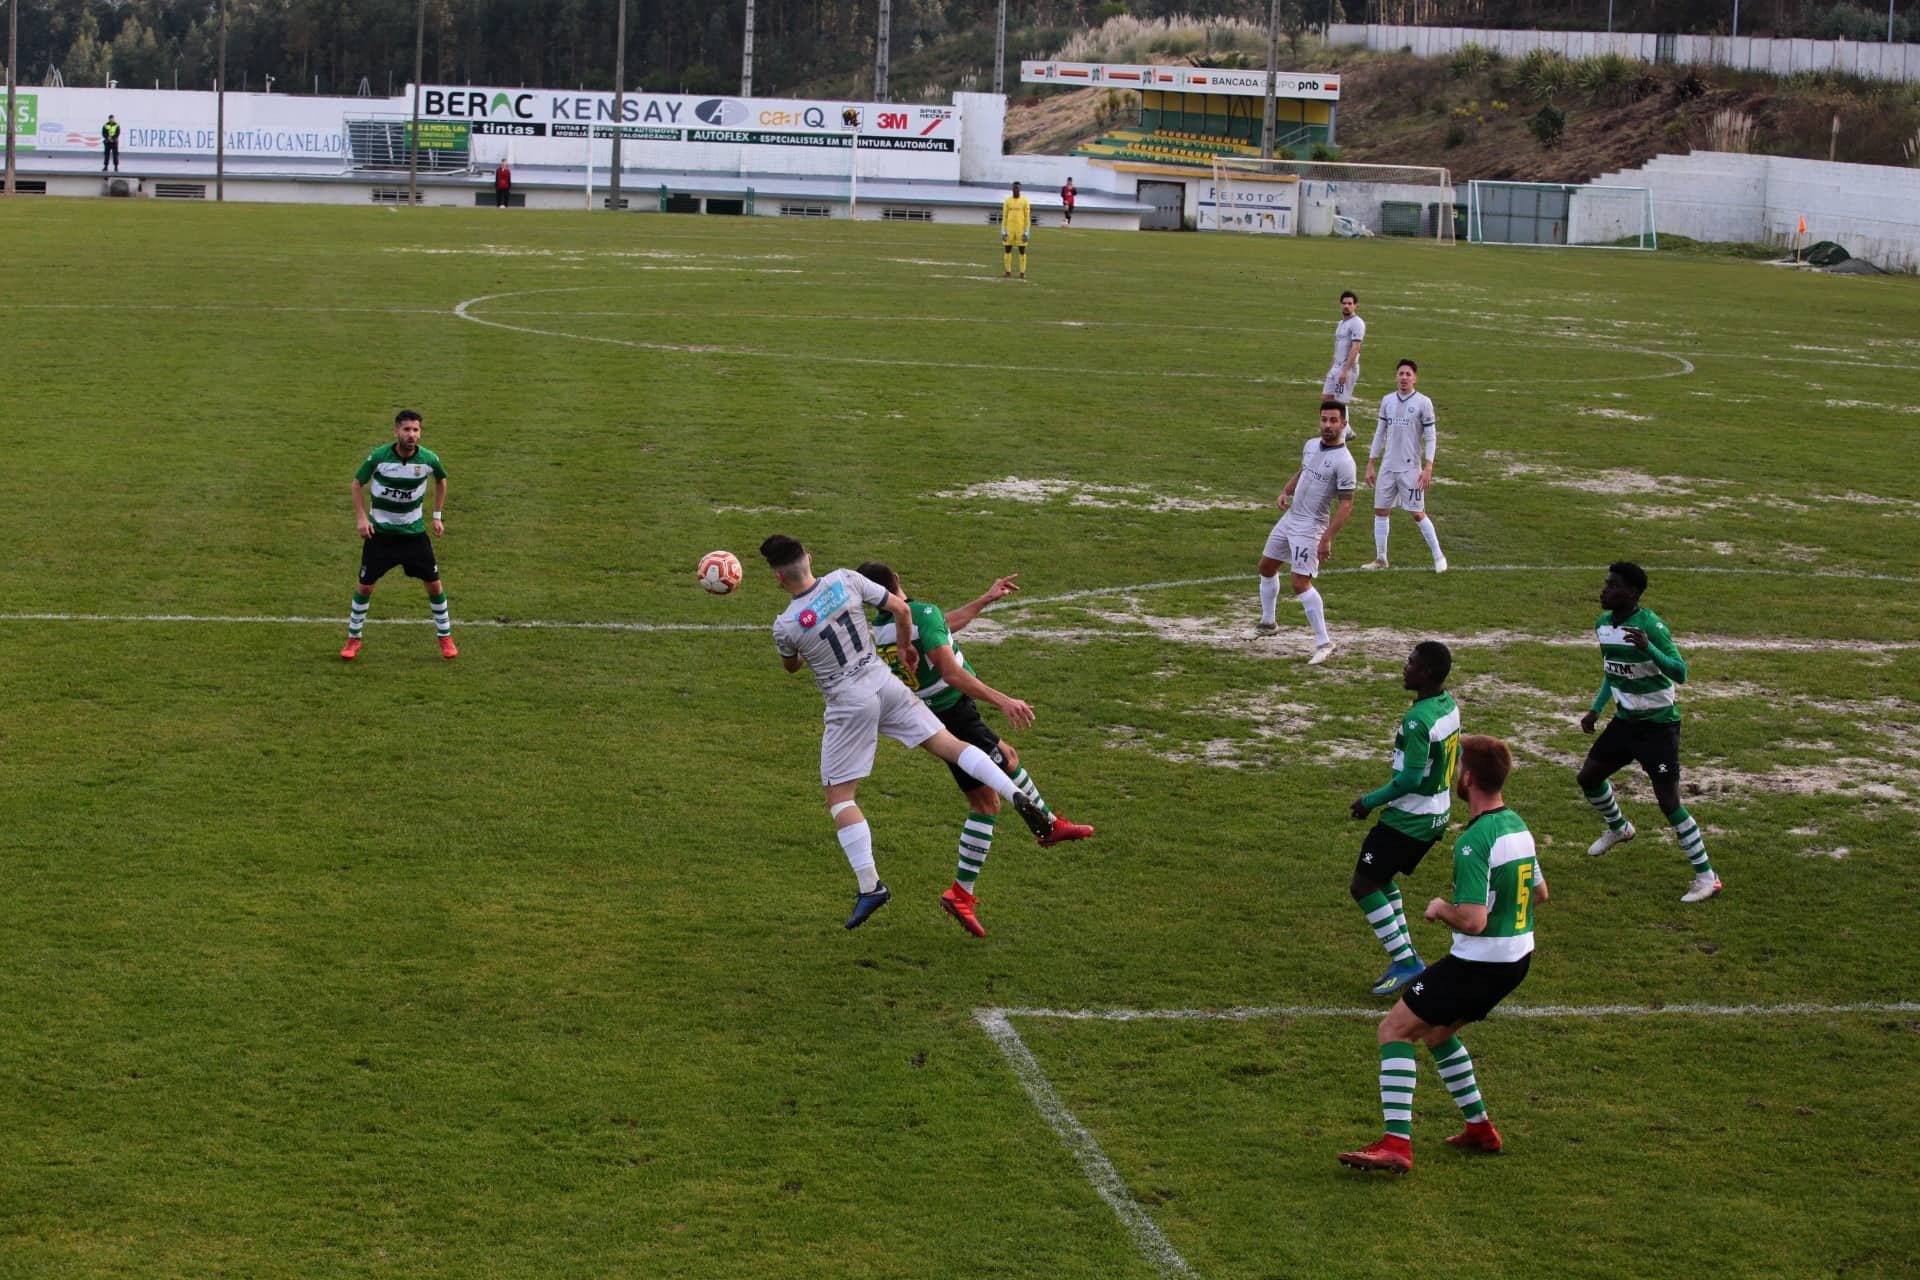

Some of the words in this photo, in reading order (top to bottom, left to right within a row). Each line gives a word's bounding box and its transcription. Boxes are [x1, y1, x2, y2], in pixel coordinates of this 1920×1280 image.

[1212, 77, 1258, 87] BANCADA
[1261, 80, 1295, 88] GUPO
[1298, 81, 1319, 91] pnb
[425, 91, 533, 118] BERAC
[552, 97, 683, 123] KENSAY
[482, 123, 535, 135] tintas
[877, 113, 908, 130] 3M
[129, 128, 192, 149] EMPRESA
[197, 130, 215, 149] DE
[221, 128, 272, 151] ARTÃO
[609, 132, 677, 140] MTALOMECÂNICA
[693, 131, 750, 142] AUTOFLEX
[760, 135, 824, 145] ESPECIALISTAS
[826, 138, 840, 146] EM
[842, 138, 891, 148] REINTURA
[894, 139, 948, 151] AUTOMÓVEL
[381, 487, 413, 500] JTM
[1408, 488, 1421, 501] 70
[1294, 546, 1309, 563] 14
[819, 610, 863, 668] 11
[1515, 863, 1532, 929] 5
